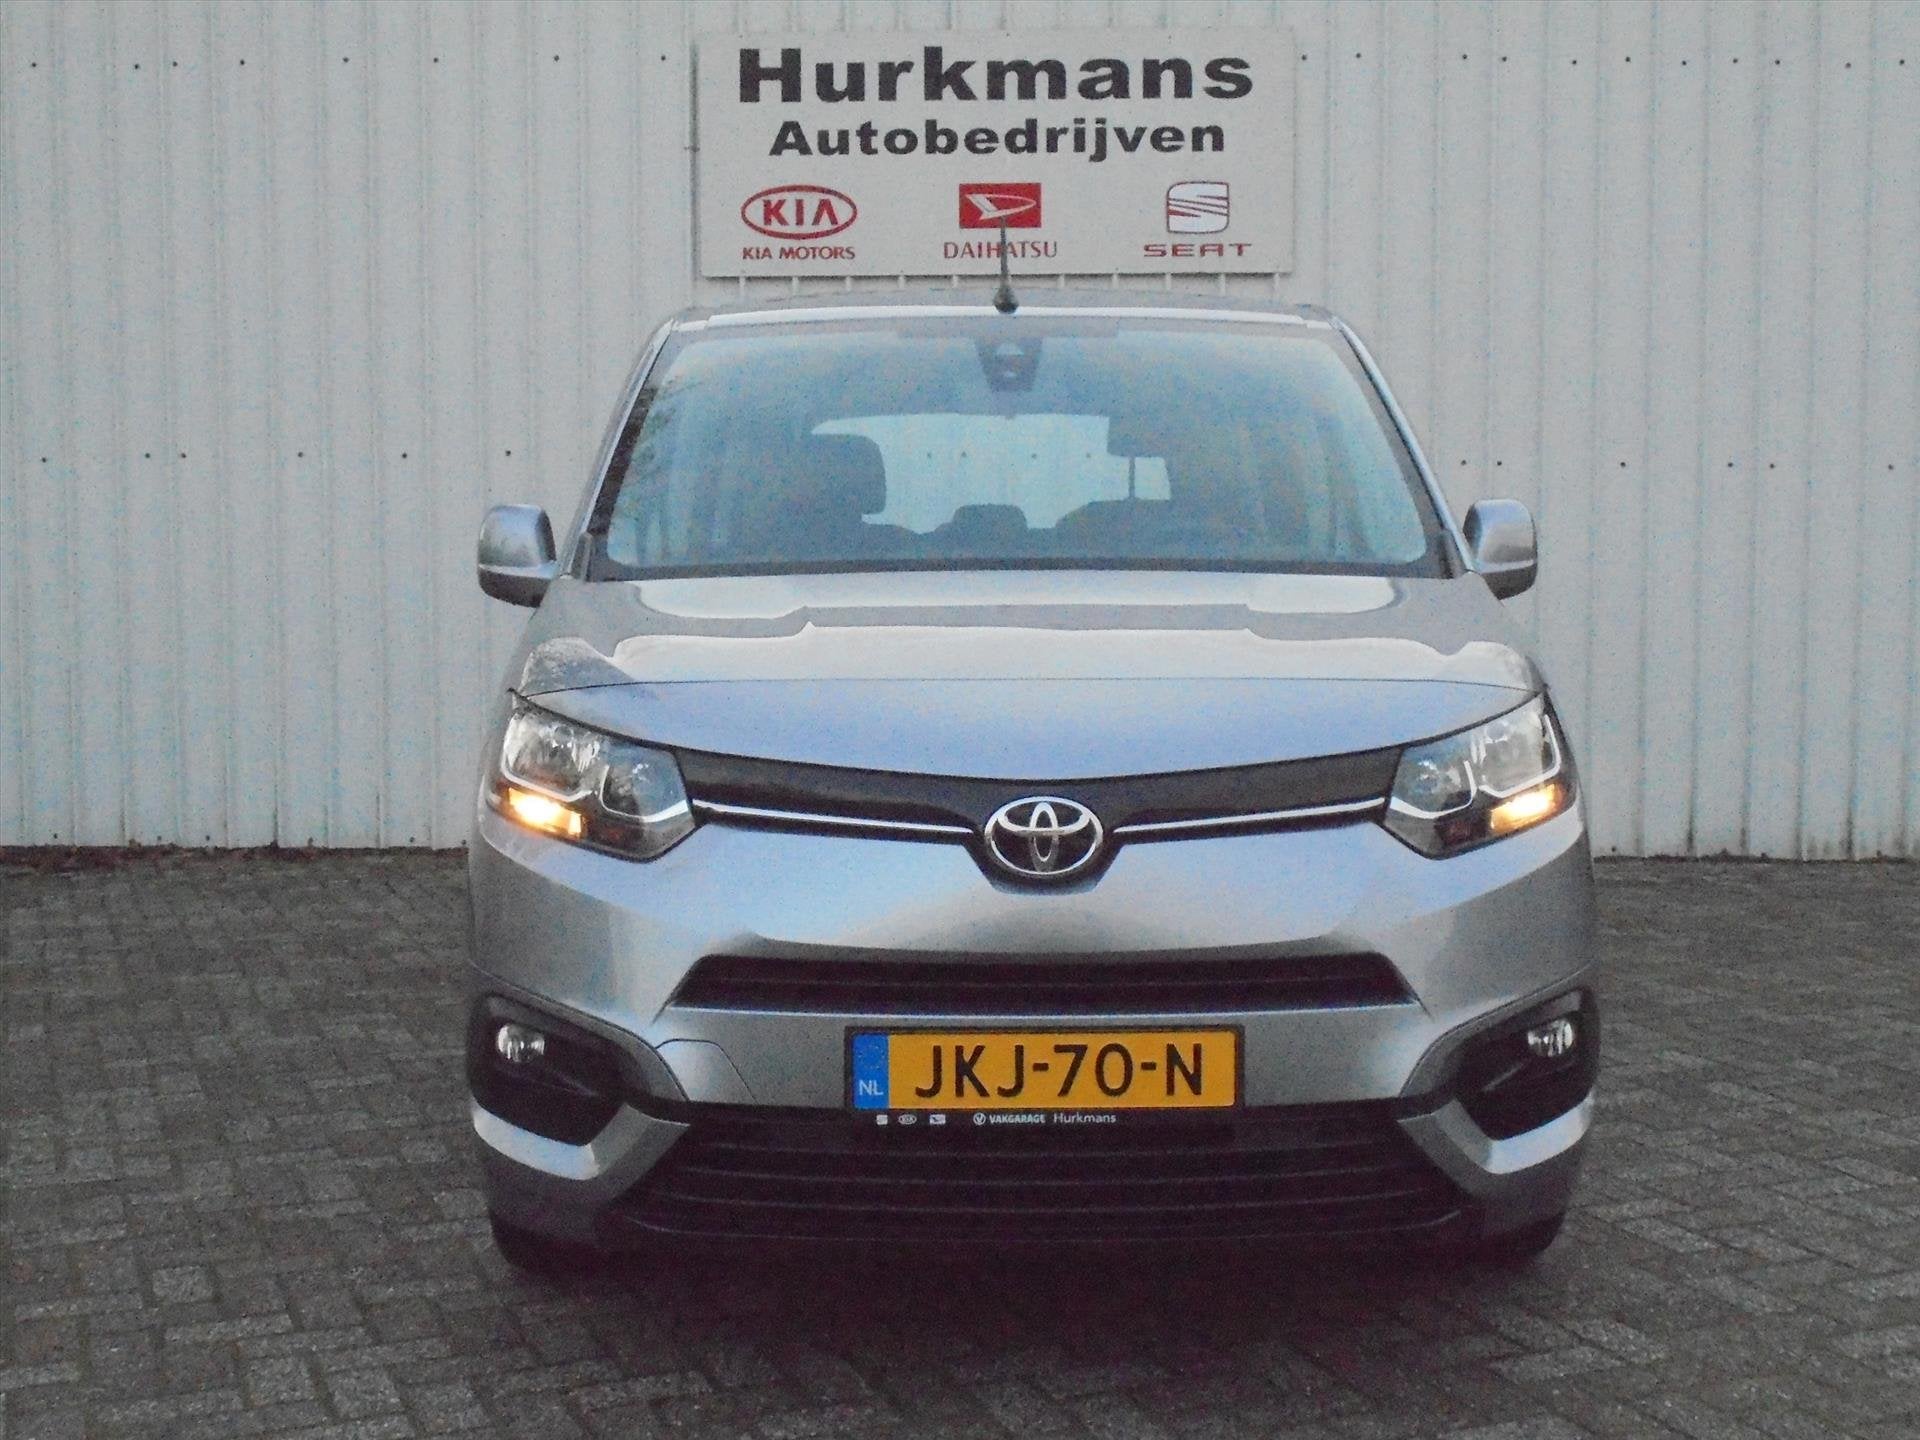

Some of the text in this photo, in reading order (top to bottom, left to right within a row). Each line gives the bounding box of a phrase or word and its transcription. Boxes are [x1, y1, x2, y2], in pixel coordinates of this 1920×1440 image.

[739, 46, 1254, 103] Hurkmans
[769, 117, 1225, 162] Autobedrijven
[762, 198, 839, 226] KIA
[742, 246, 856, 260] KIA MOTORS
[943, 240, 1058, 259] DAIHATSU
[1143, 243, 1252, 257] SEAT
[915, 1043, 1202, 1097] JKJ-70-N
[859, 1078, 884, 1096] NL
[989, 1112, 1117, 1124] VAKGARAGE Hurkmans
